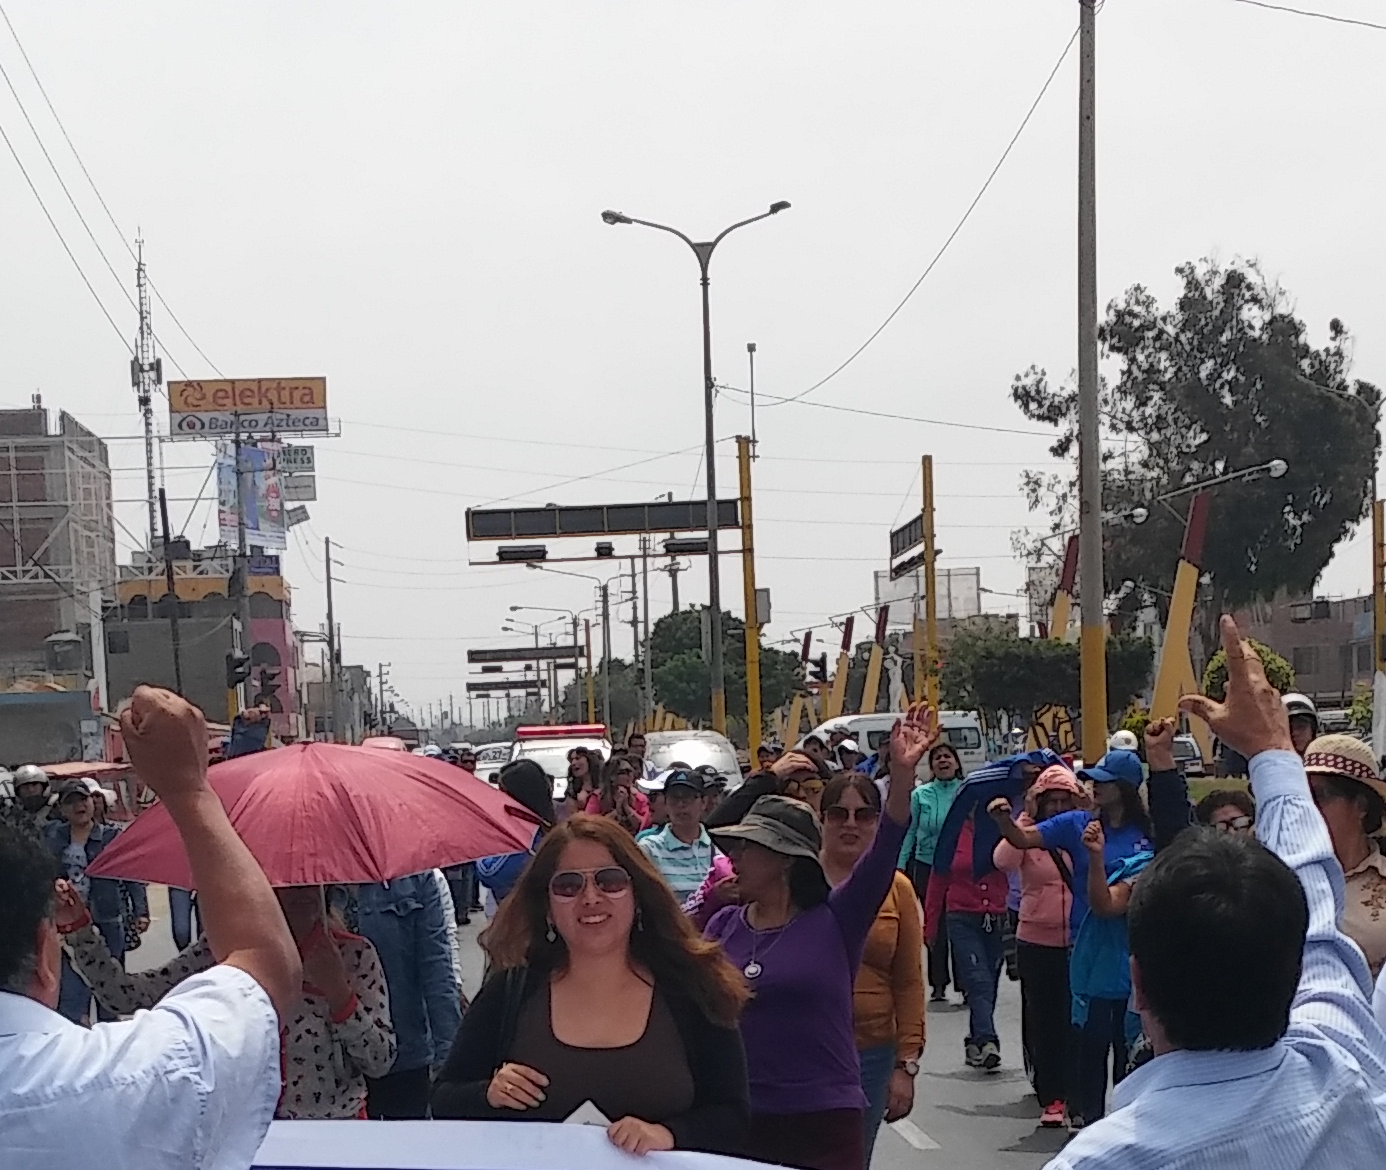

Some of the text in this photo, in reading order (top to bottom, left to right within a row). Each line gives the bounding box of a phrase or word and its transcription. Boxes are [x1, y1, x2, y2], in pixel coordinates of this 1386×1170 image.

[213, 381, 315, 407] elektra
[208, 412, 320, 431] Banco Azteca
